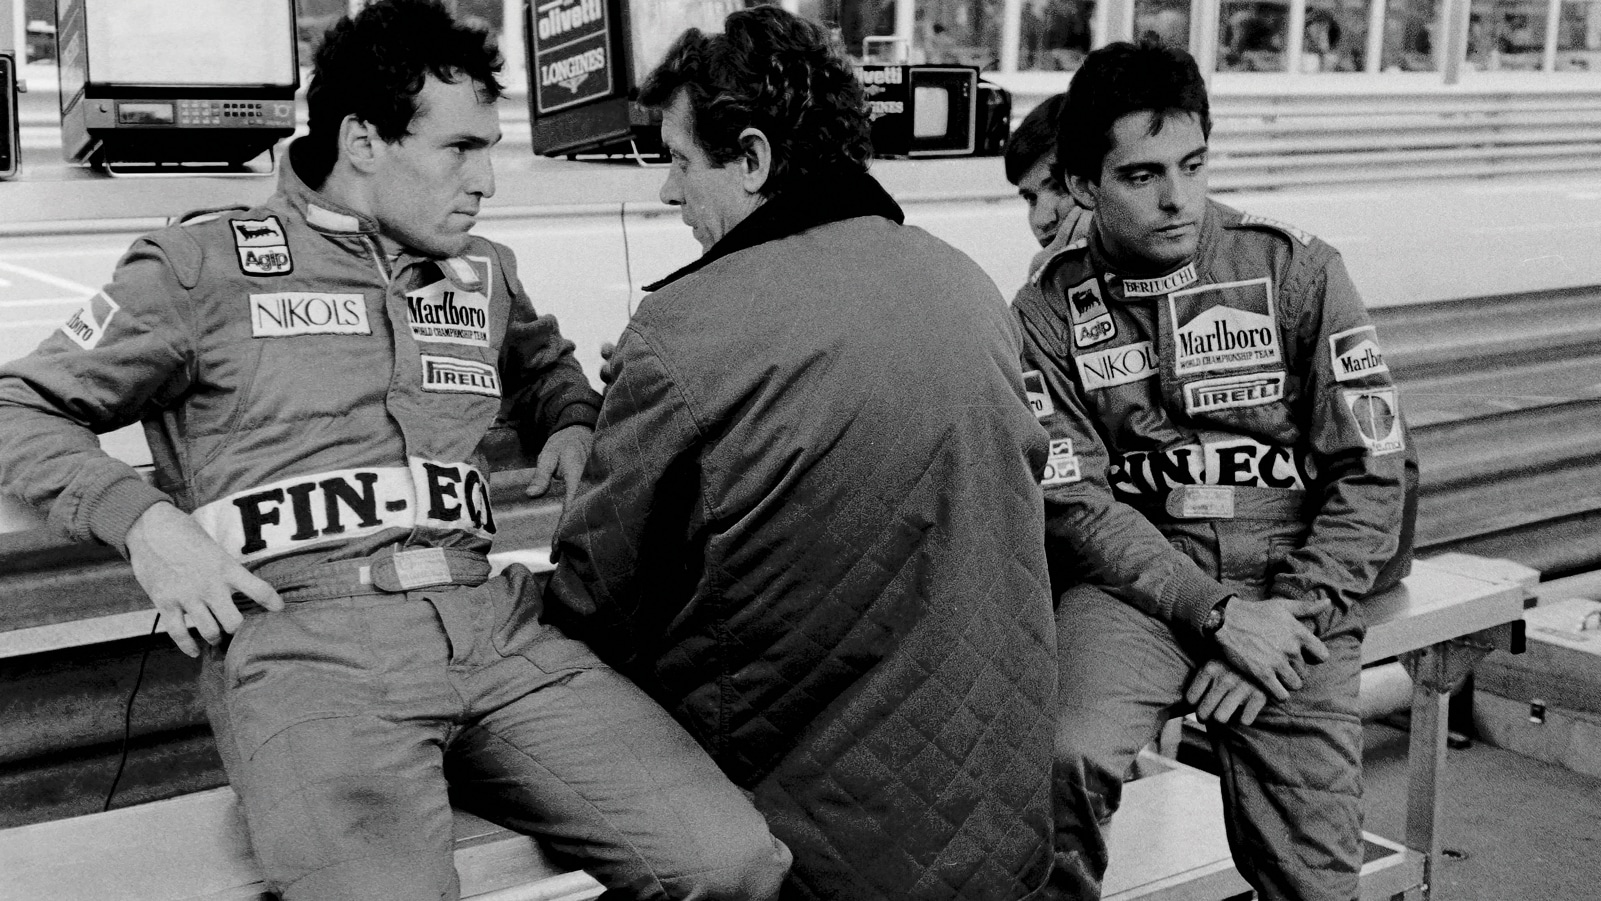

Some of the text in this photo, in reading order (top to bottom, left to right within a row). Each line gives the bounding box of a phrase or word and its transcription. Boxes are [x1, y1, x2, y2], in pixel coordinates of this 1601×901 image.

[541, 47, 605, 86] LONGINES
[853, 66, 903, 84] ivetti
[245, 249, 289, 272] Agip
[65, 307, 94, 342] lboro
[257, 298, 360, 329] NIKOLS
[407, 291, 486, 329] Marlboro
[412, 326, 488, 341] WORLD CHAMPIONSHIP TEAM
[1080, 320, 1112, 342] Agip
[1179, 319, 1272, 358] Marlboro
[1083, 346, 1160, 384] NIKOL
[1180, 348, 1275, 369] WORLD CHAMPIONSHIP TEAM
[1340, 347, 1382, 374] Marlb
[426, 360, 496, 390] PIRELLI
[1190, 377, 1281, 408] PIRELLI
